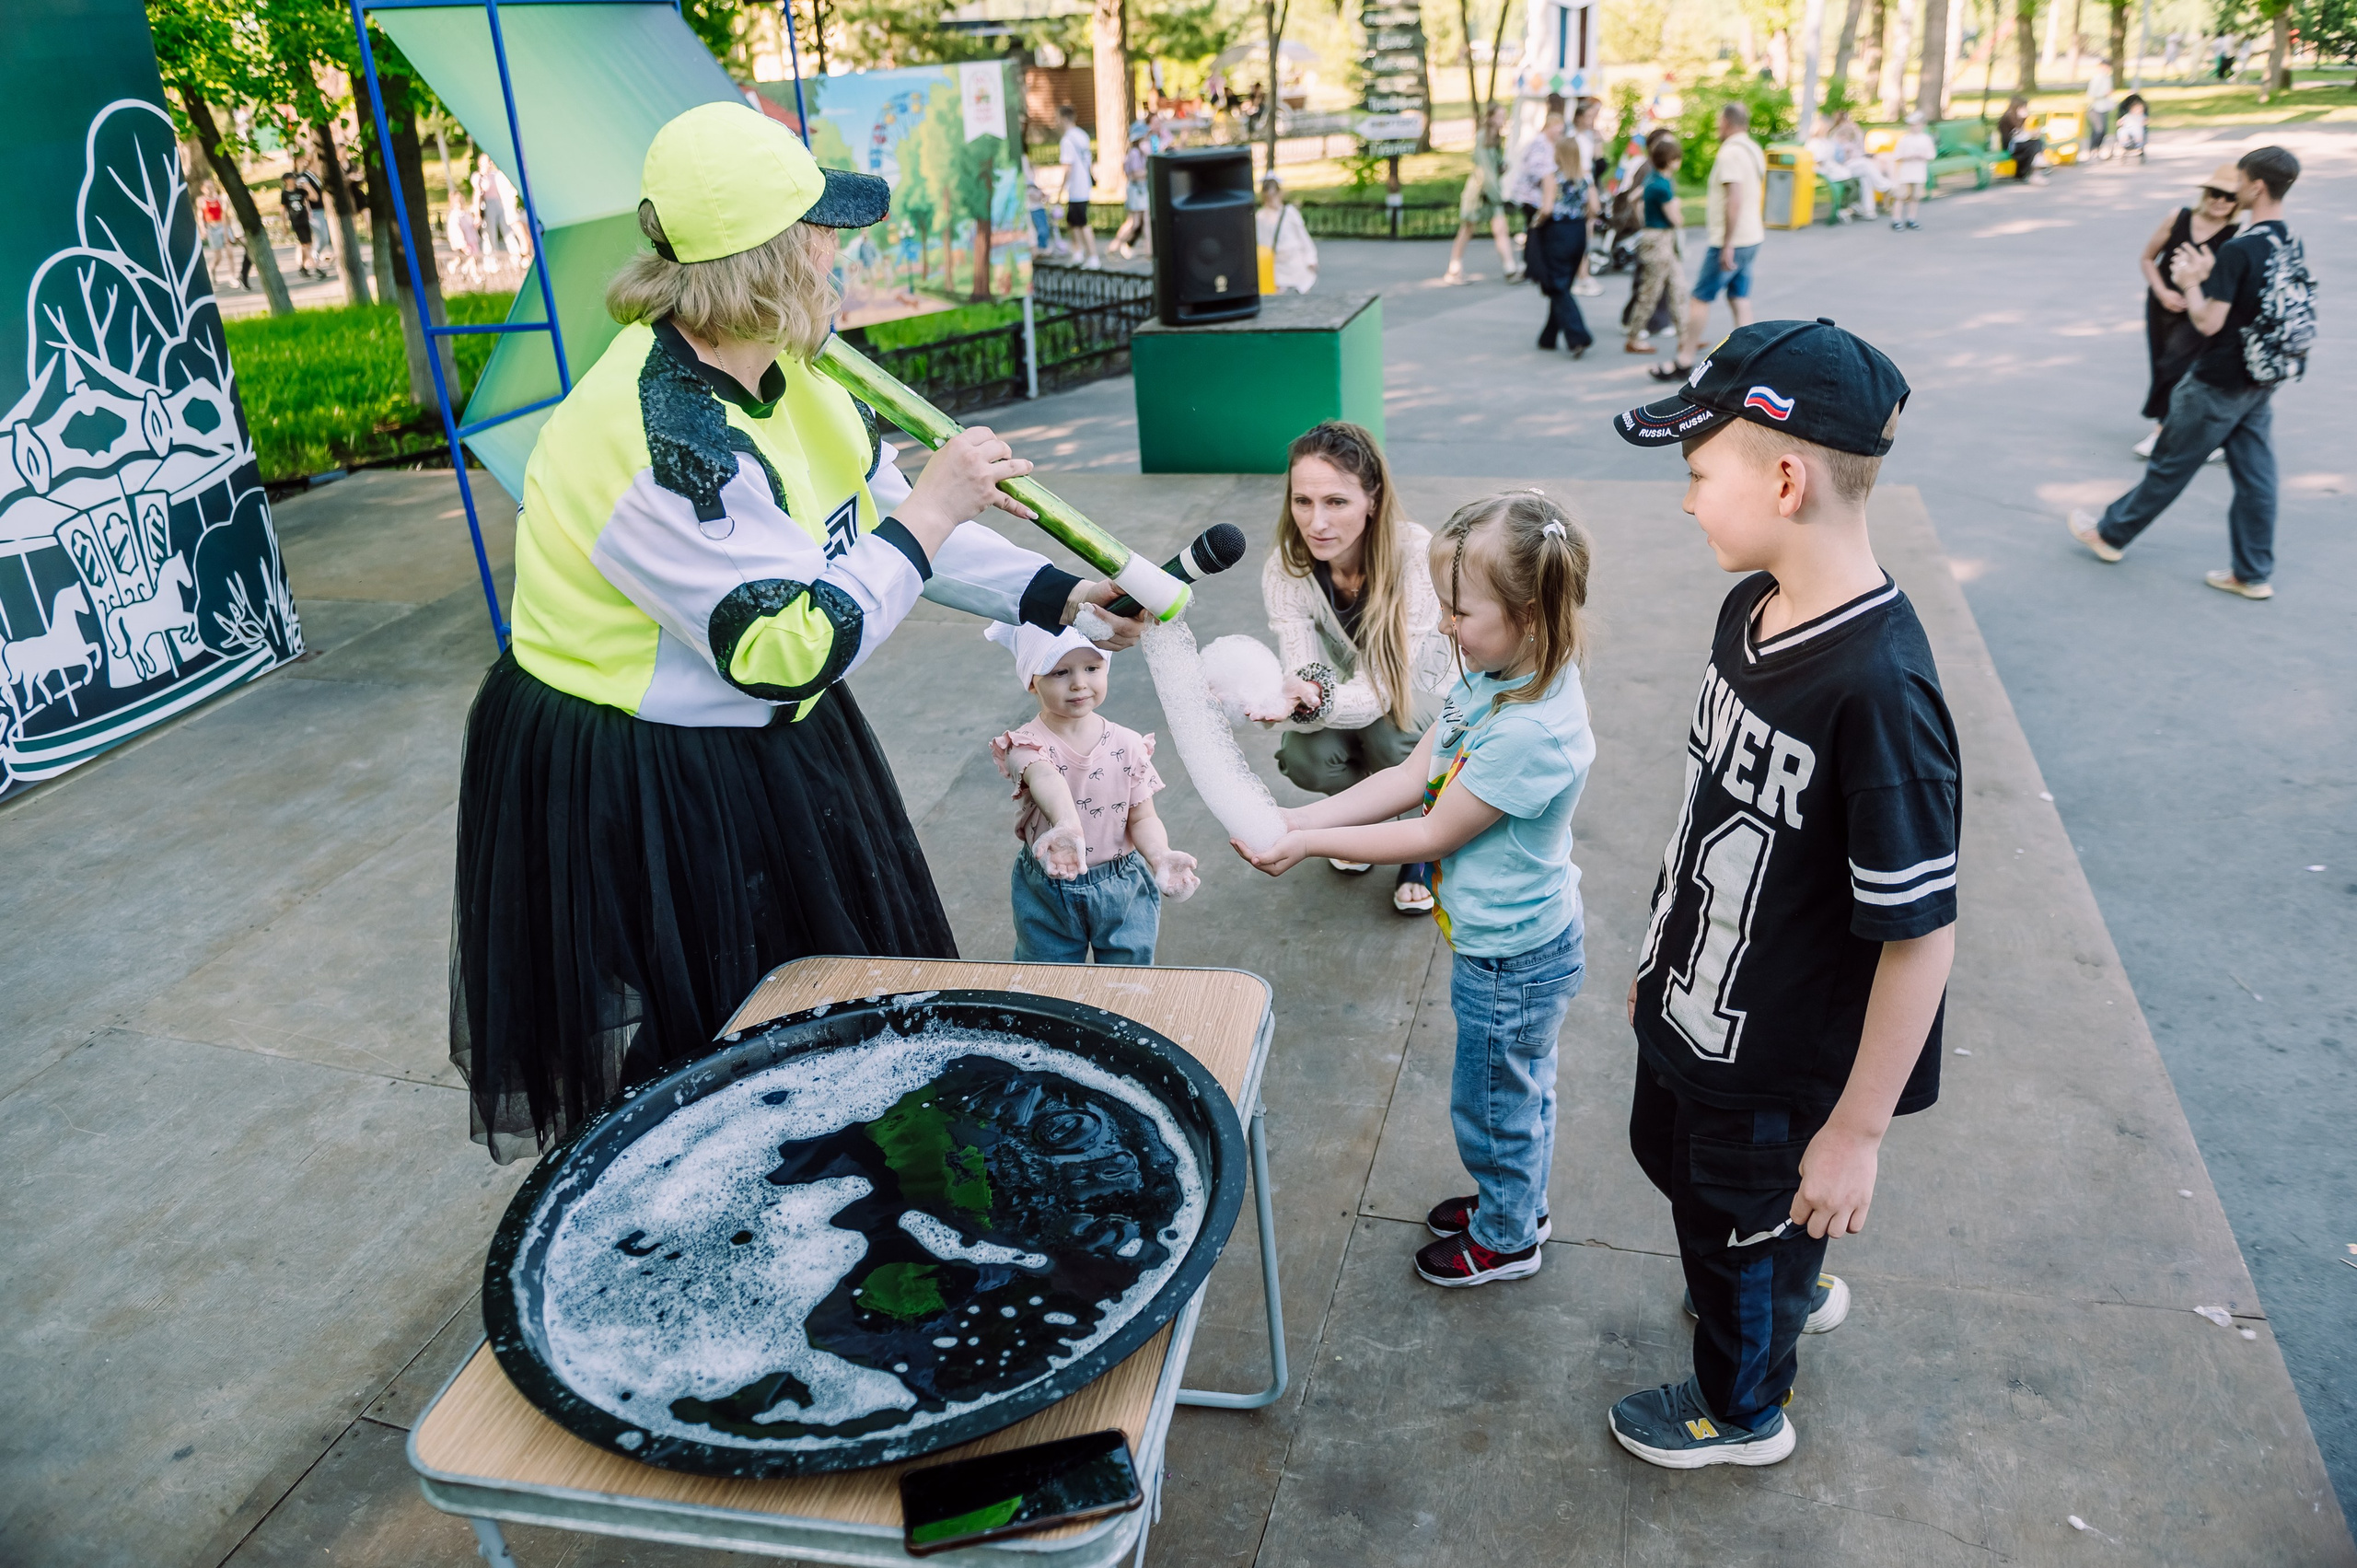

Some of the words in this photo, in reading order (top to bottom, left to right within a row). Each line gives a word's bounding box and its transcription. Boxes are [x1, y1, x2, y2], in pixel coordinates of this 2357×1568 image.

[1639, 428, 1672, 437] RUSSIA
[1678, 411, 1713, 432] RUSSIA
[1691, 662, 1817, 830] OWER
